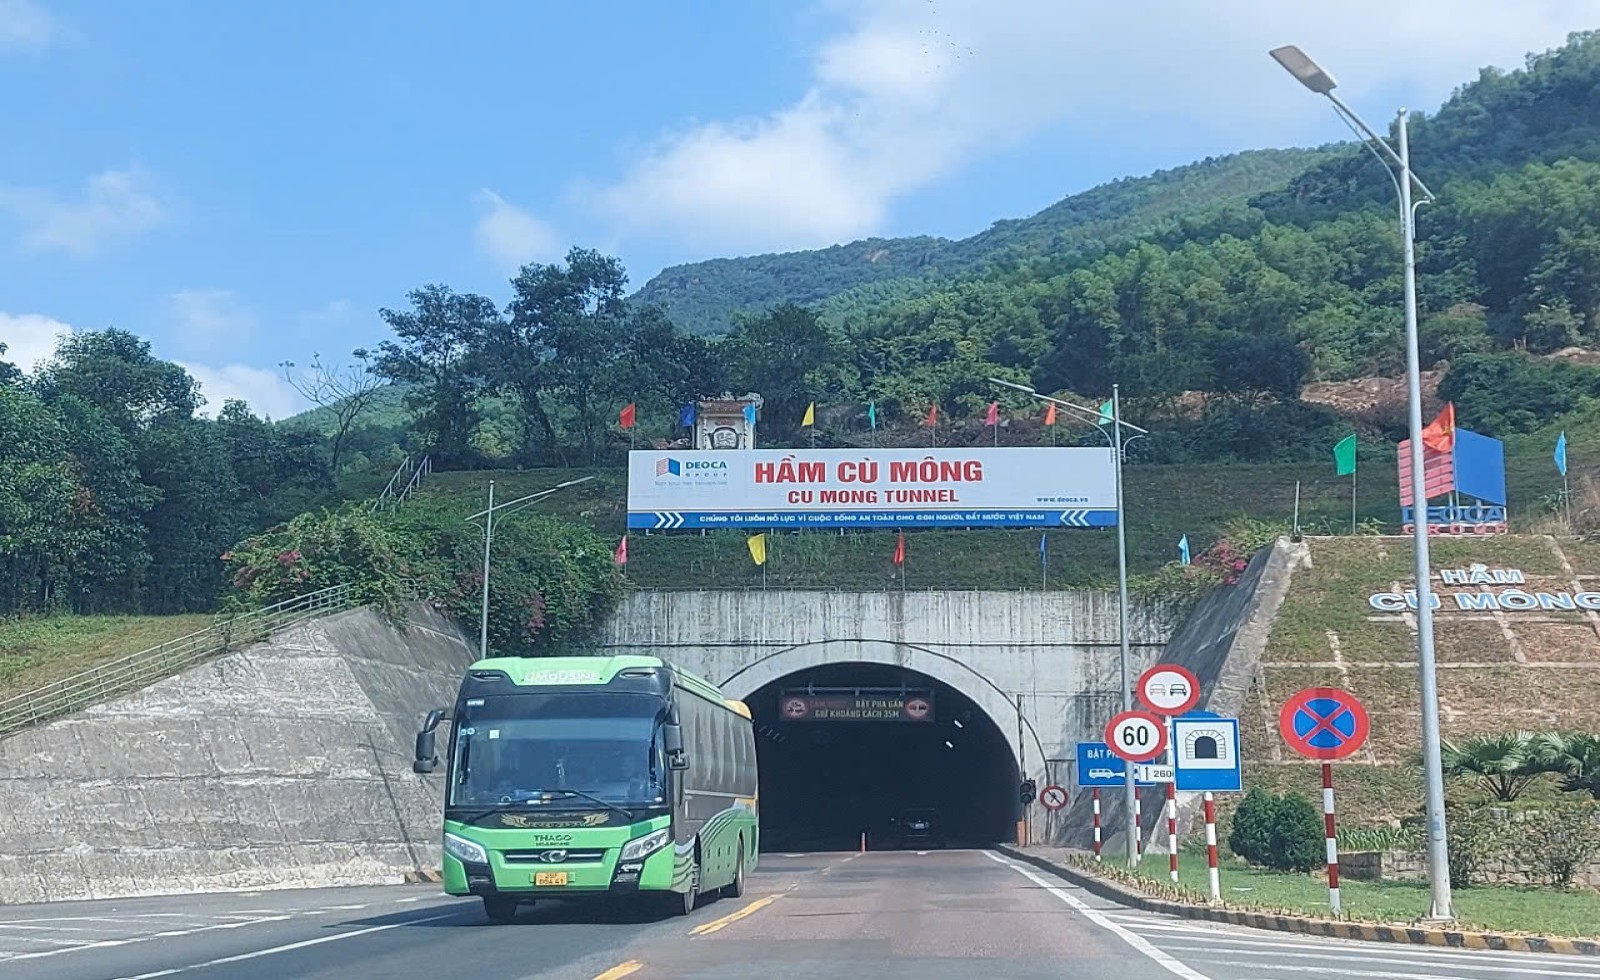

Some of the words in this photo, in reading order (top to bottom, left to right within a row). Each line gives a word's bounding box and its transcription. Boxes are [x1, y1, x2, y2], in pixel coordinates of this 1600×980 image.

[685, 461, 727, 469] DEOCA
[755, 454, 826, 483] HẦM
[837, 456, 878, 483] CÙ
[890, 455, 983, 483] MÔNG
[788, 490, 813, 503] CU
[820, 490, 878, 503] MONG
[884, 489, 959, 503] TUNNEL
[872, 513, 895, 521] TOÀN
[1440, 563, 1526, 585] HẦM
[1123, 725, 1149, 746] 60
[1153, 770, 1174, 778] 260
